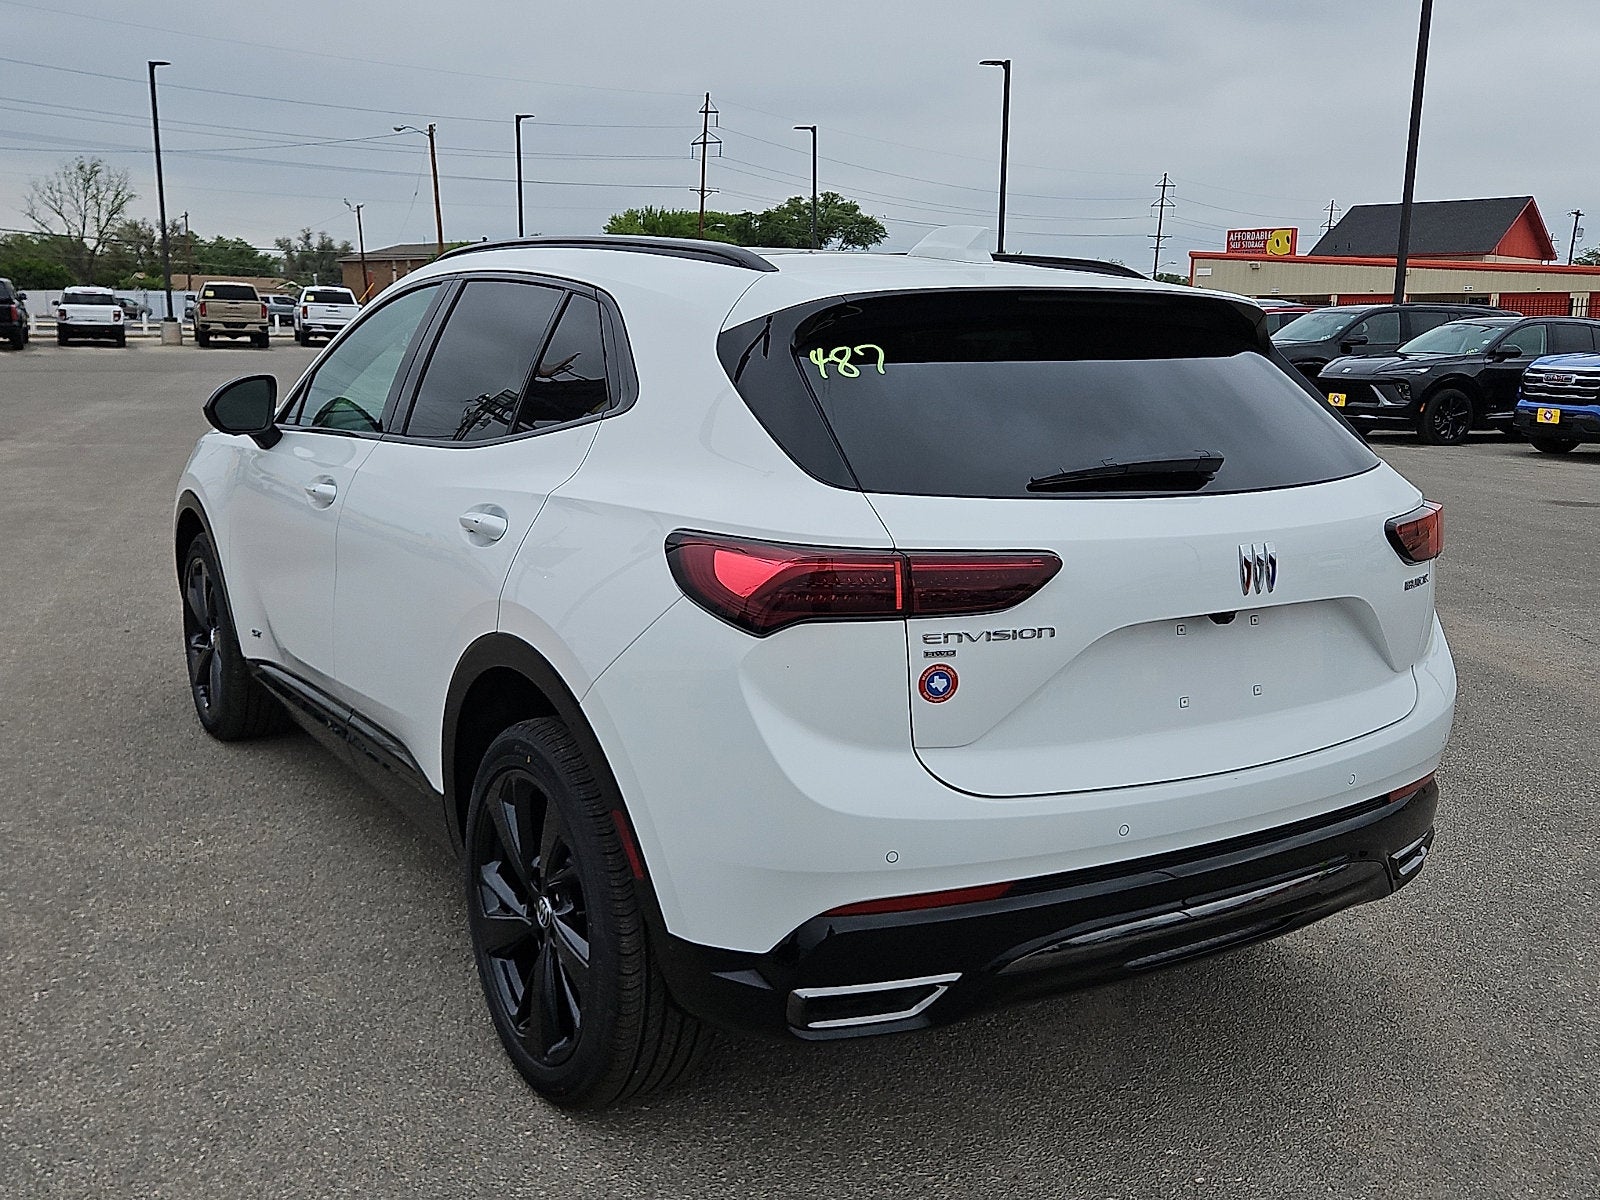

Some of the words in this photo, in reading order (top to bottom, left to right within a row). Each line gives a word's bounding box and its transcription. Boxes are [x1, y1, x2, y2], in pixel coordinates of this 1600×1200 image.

[1229, 231, 1273, 241] AFFORDABLE
[1230, 241, 1240, 249] SELF
[1241, 240, 1265, 249] STORAGE
[809, 344, 886, 379] 487
[1404, 573, 1429, 591] BUICK
[922, 626, 1056, 645] ENVISION
